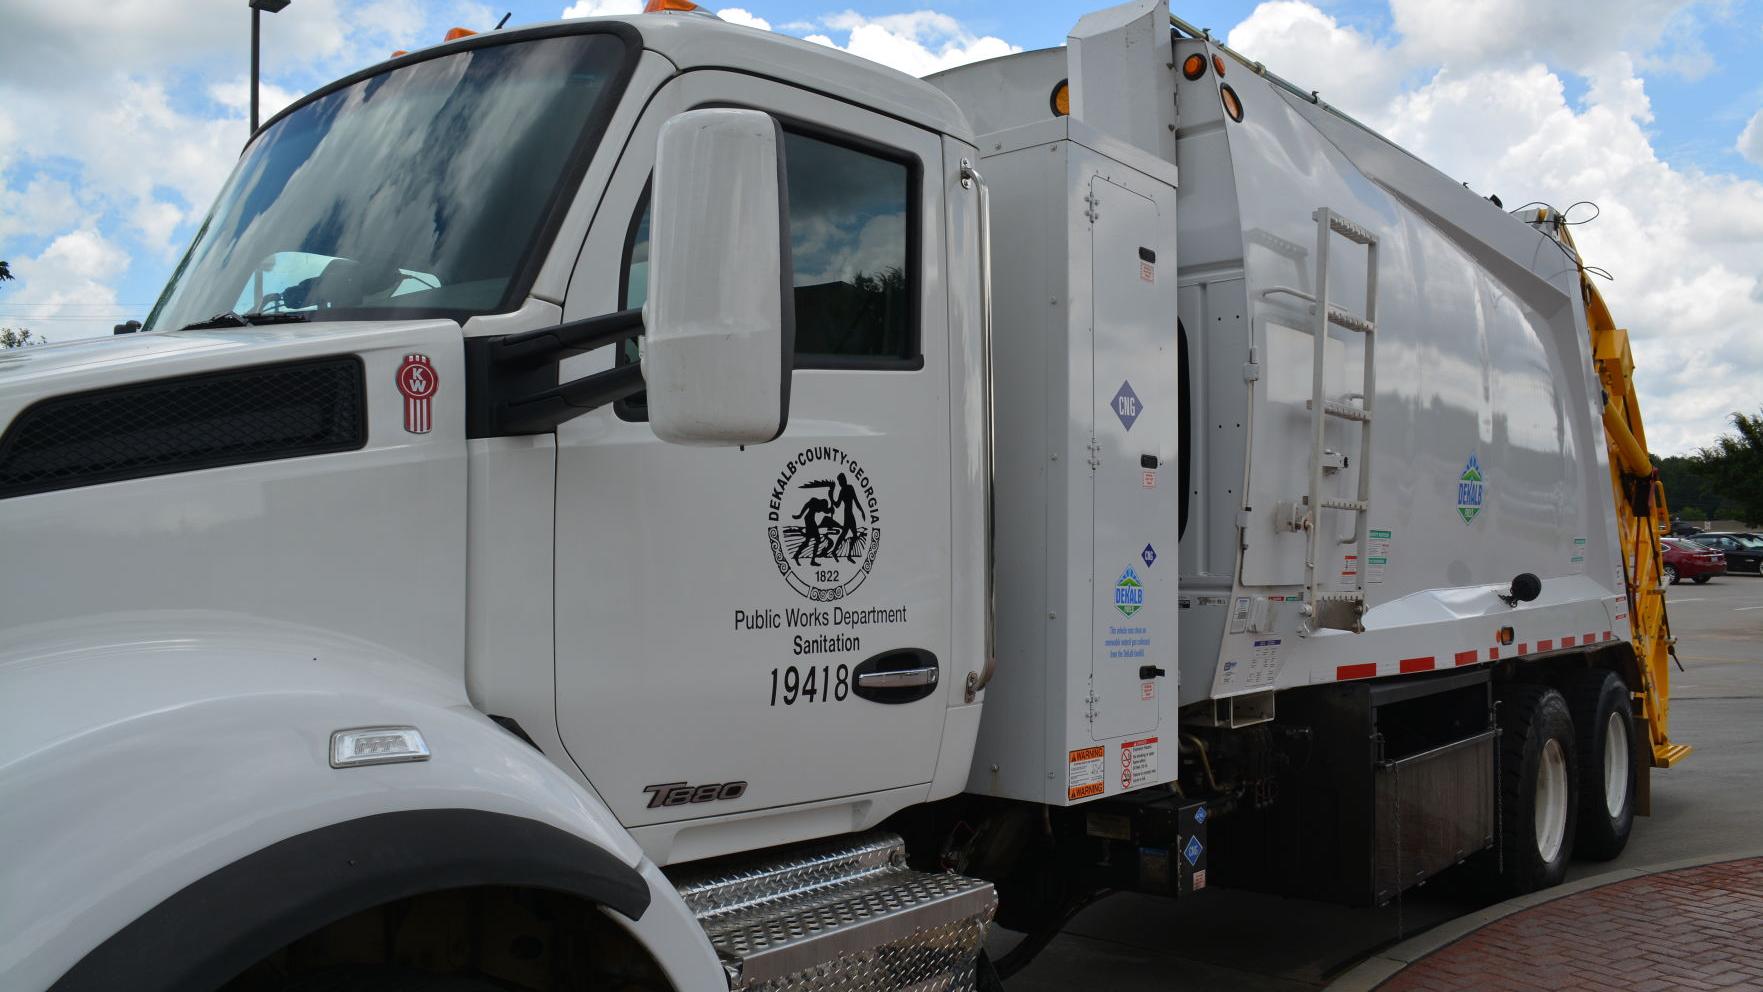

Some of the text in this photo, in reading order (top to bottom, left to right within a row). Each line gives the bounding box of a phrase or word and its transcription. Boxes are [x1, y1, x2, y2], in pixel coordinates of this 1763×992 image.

[1118, 396, 1136, 417] CNG
[768, 446, 880, 525] DEKALB COUNTY GEORGIA
[1458, 481, 1482, 505] DEKALB
[815, 570, 840, 582] 1822
[1115, 586, 1143, 604] DEKALB
[735, 605, 907, 630] Public Works Department
[793, 633, 860, 656] Sanitation
[770, 664, 849, 706] 19418
[1076, 747, 1103, 762] WARNING
[643, 781, 749, 809] T880
[1076, 783, 1103, 797] WARNING
